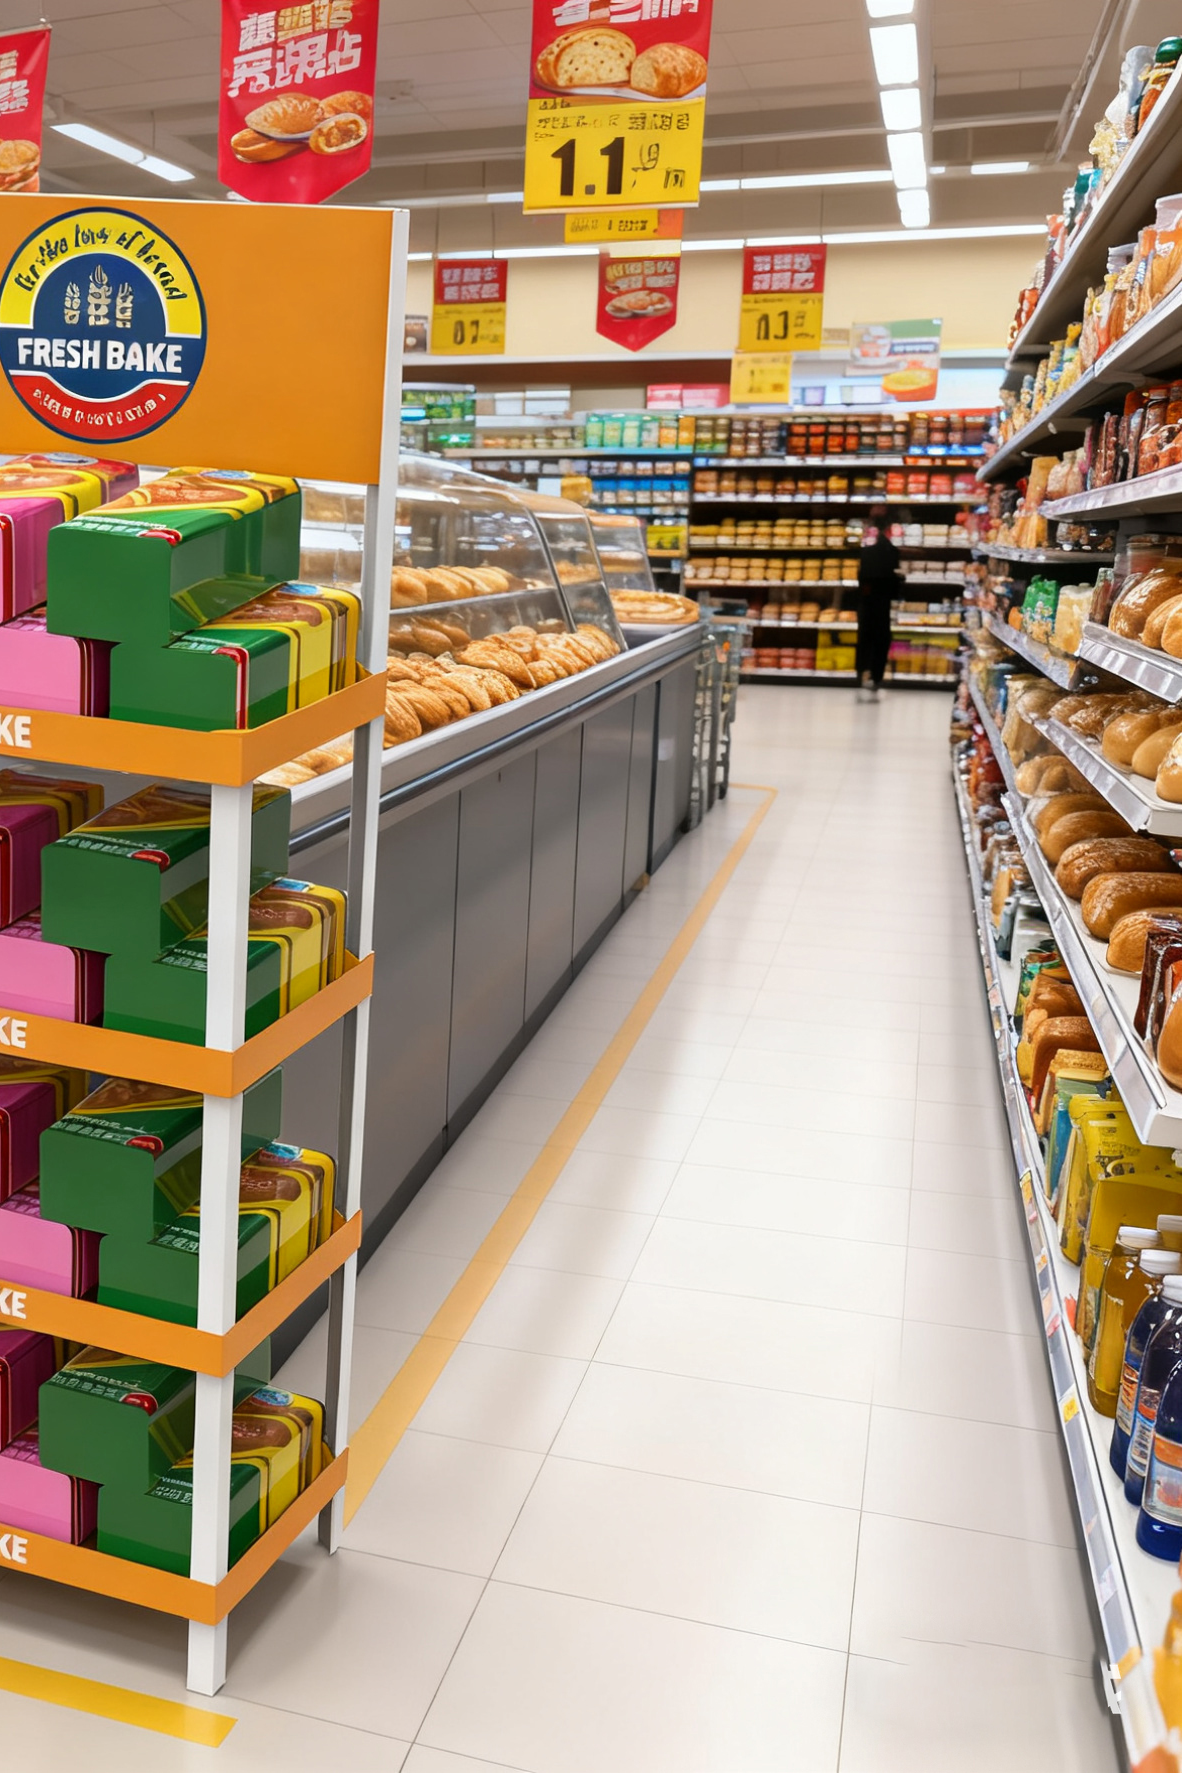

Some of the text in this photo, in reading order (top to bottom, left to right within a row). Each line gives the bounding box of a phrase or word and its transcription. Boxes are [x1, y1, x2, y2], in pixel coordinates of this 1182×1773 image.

[550, 136, 626, 197] 1.1
[17, 337, 183, 374] FRESH BAKE
